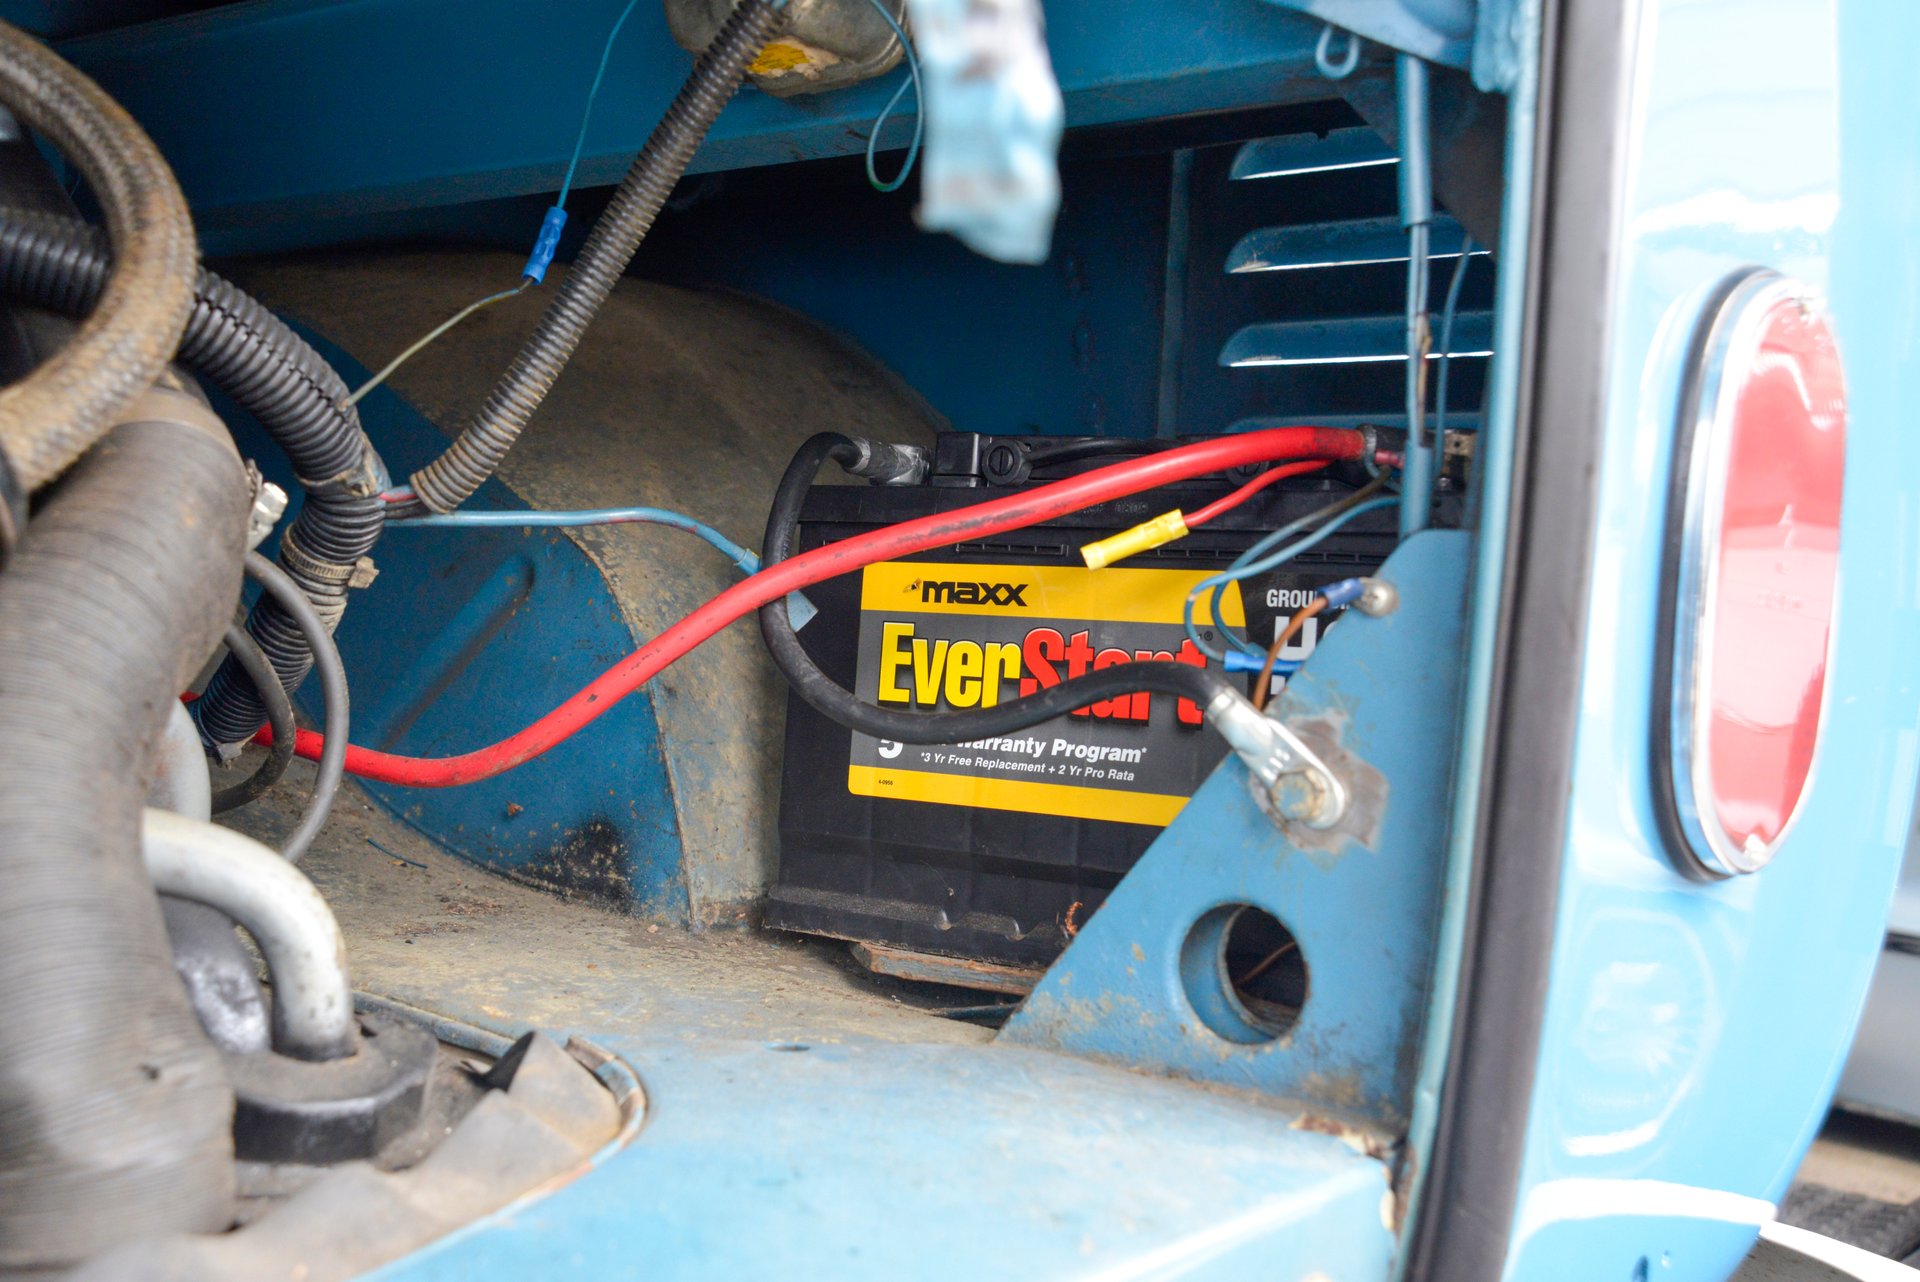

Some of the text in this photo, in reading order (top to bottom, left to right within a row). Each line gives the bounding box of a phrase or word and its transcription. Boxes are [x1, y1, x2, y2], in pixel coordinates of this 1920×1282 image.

[921, 580, 1028, 607] maxx
[1266, 589, 1318, 608] GROU
[934, 753, 945, 764] Yr
[947, 754, 972, 766] Free
[975, 757, 1046, 773] Replacement
[1058, 764, 1066, 775] 2
[1069, 765, 1082, 776] Yr
[1084, 766, 1104, 778] Pro
[1107, 768, 1135, 781] Rata
